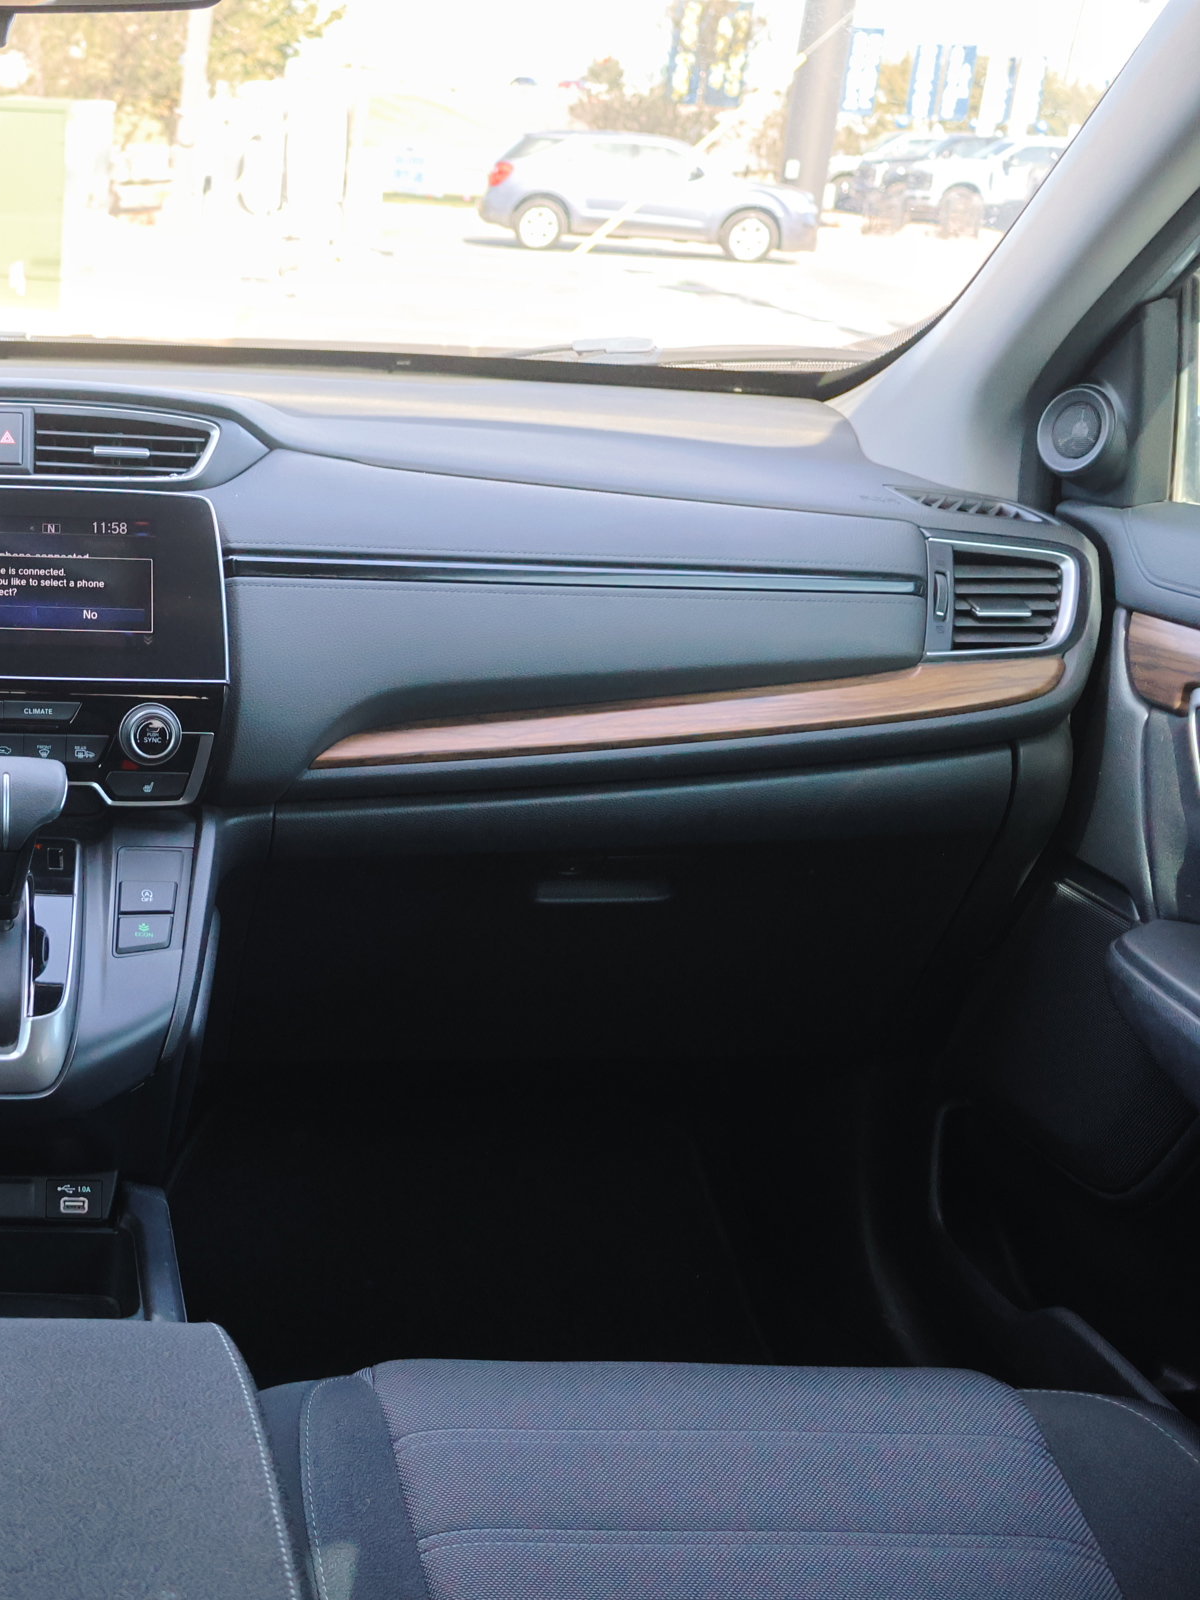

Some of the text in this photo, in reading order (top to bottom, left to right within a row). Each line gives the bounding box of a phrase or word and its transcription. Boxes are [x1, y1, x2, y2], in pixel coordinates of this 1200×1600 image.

[47, 524, 56, 534] N
[92, 522, 128, 535] 11:58
[8, 567, 16, 576] is
[18, 568, 66, 577] connected.
[10, 578, 27, 587] like
[29, 579, 37, 587] to
[40, 579, 67, 588] select
[76, 580, 105, 589] phone
[83, 609, 98, 620] No
